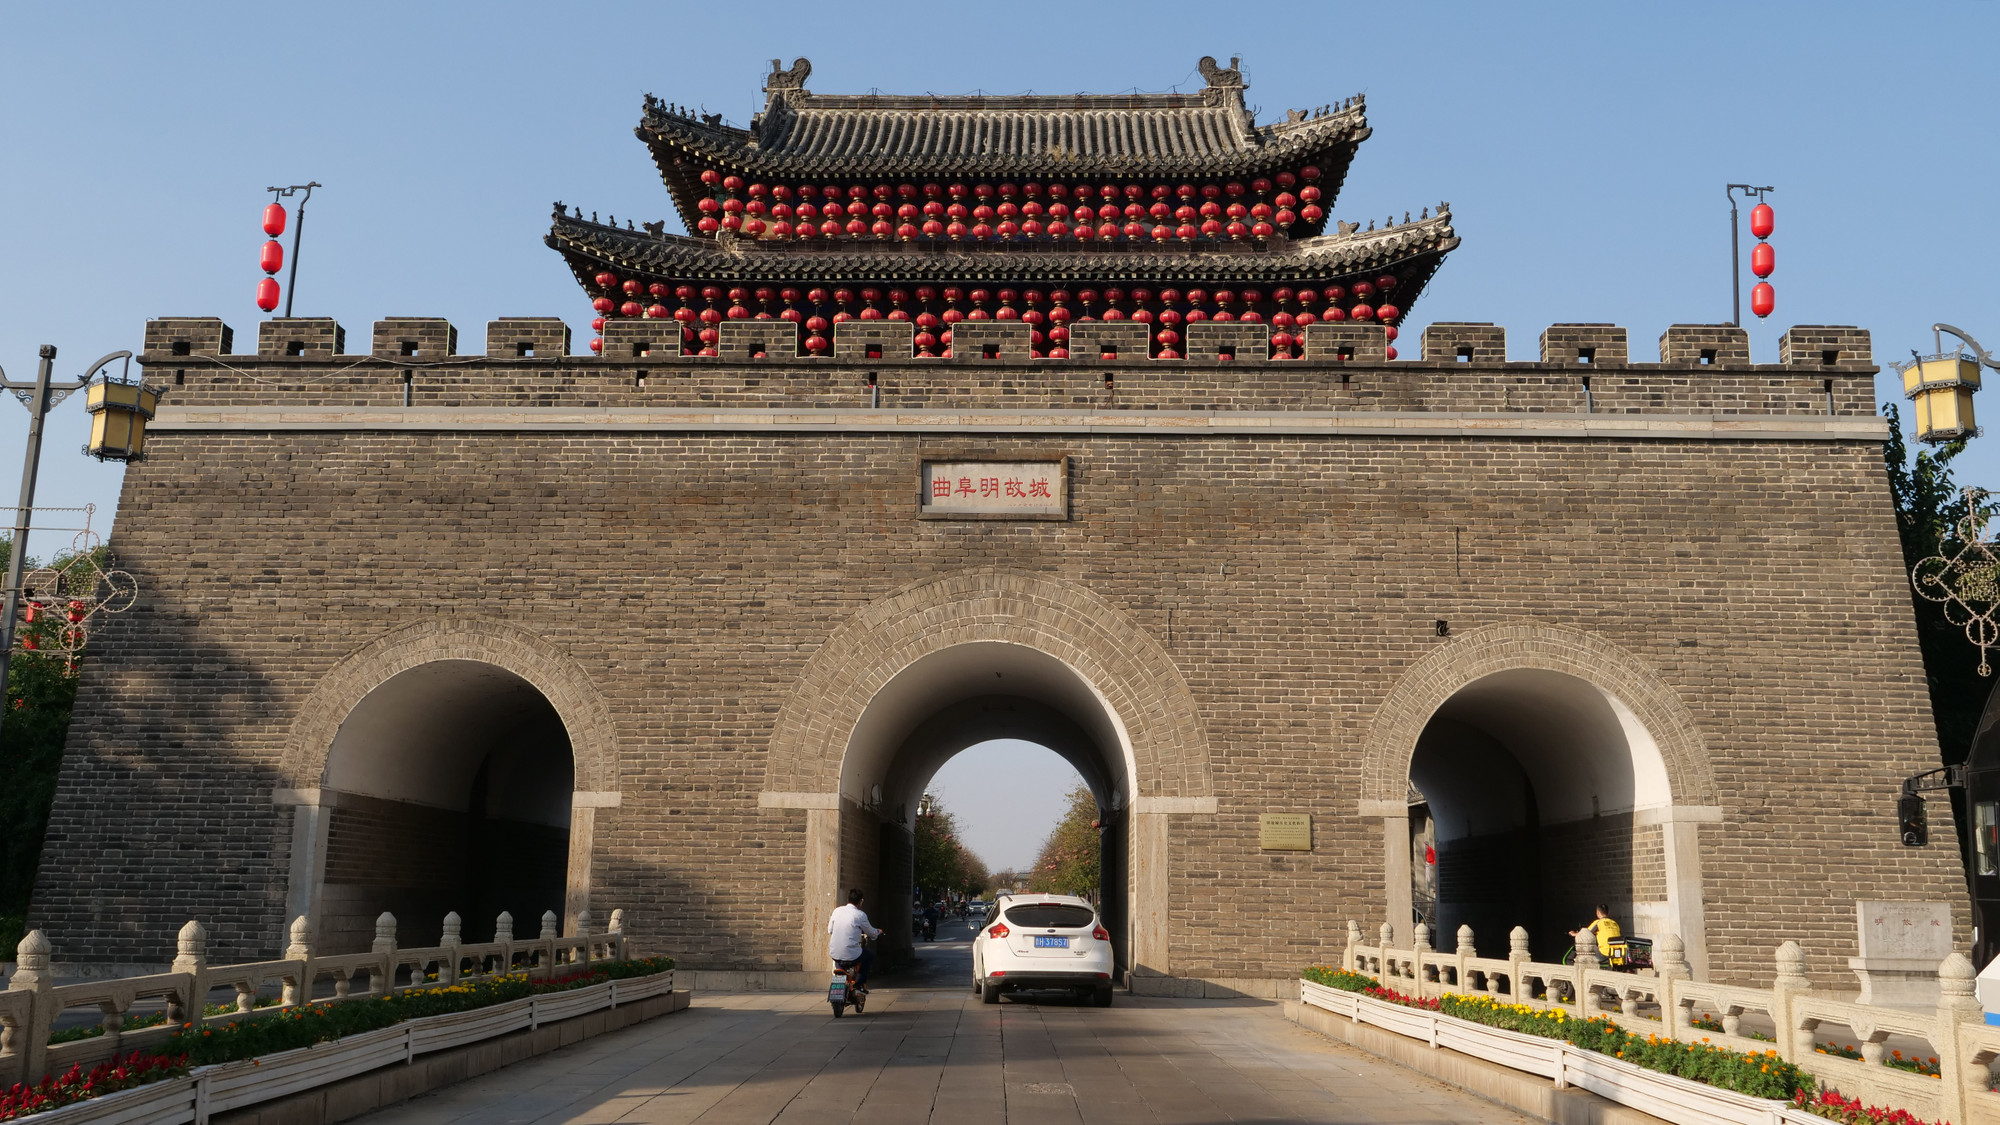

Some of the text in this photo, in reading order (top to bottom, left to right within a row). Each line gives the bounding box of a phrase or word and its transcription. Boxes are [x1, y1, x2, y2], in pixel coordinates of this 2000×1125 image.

[932, 476, 1051, 498] 曲阜明故城
